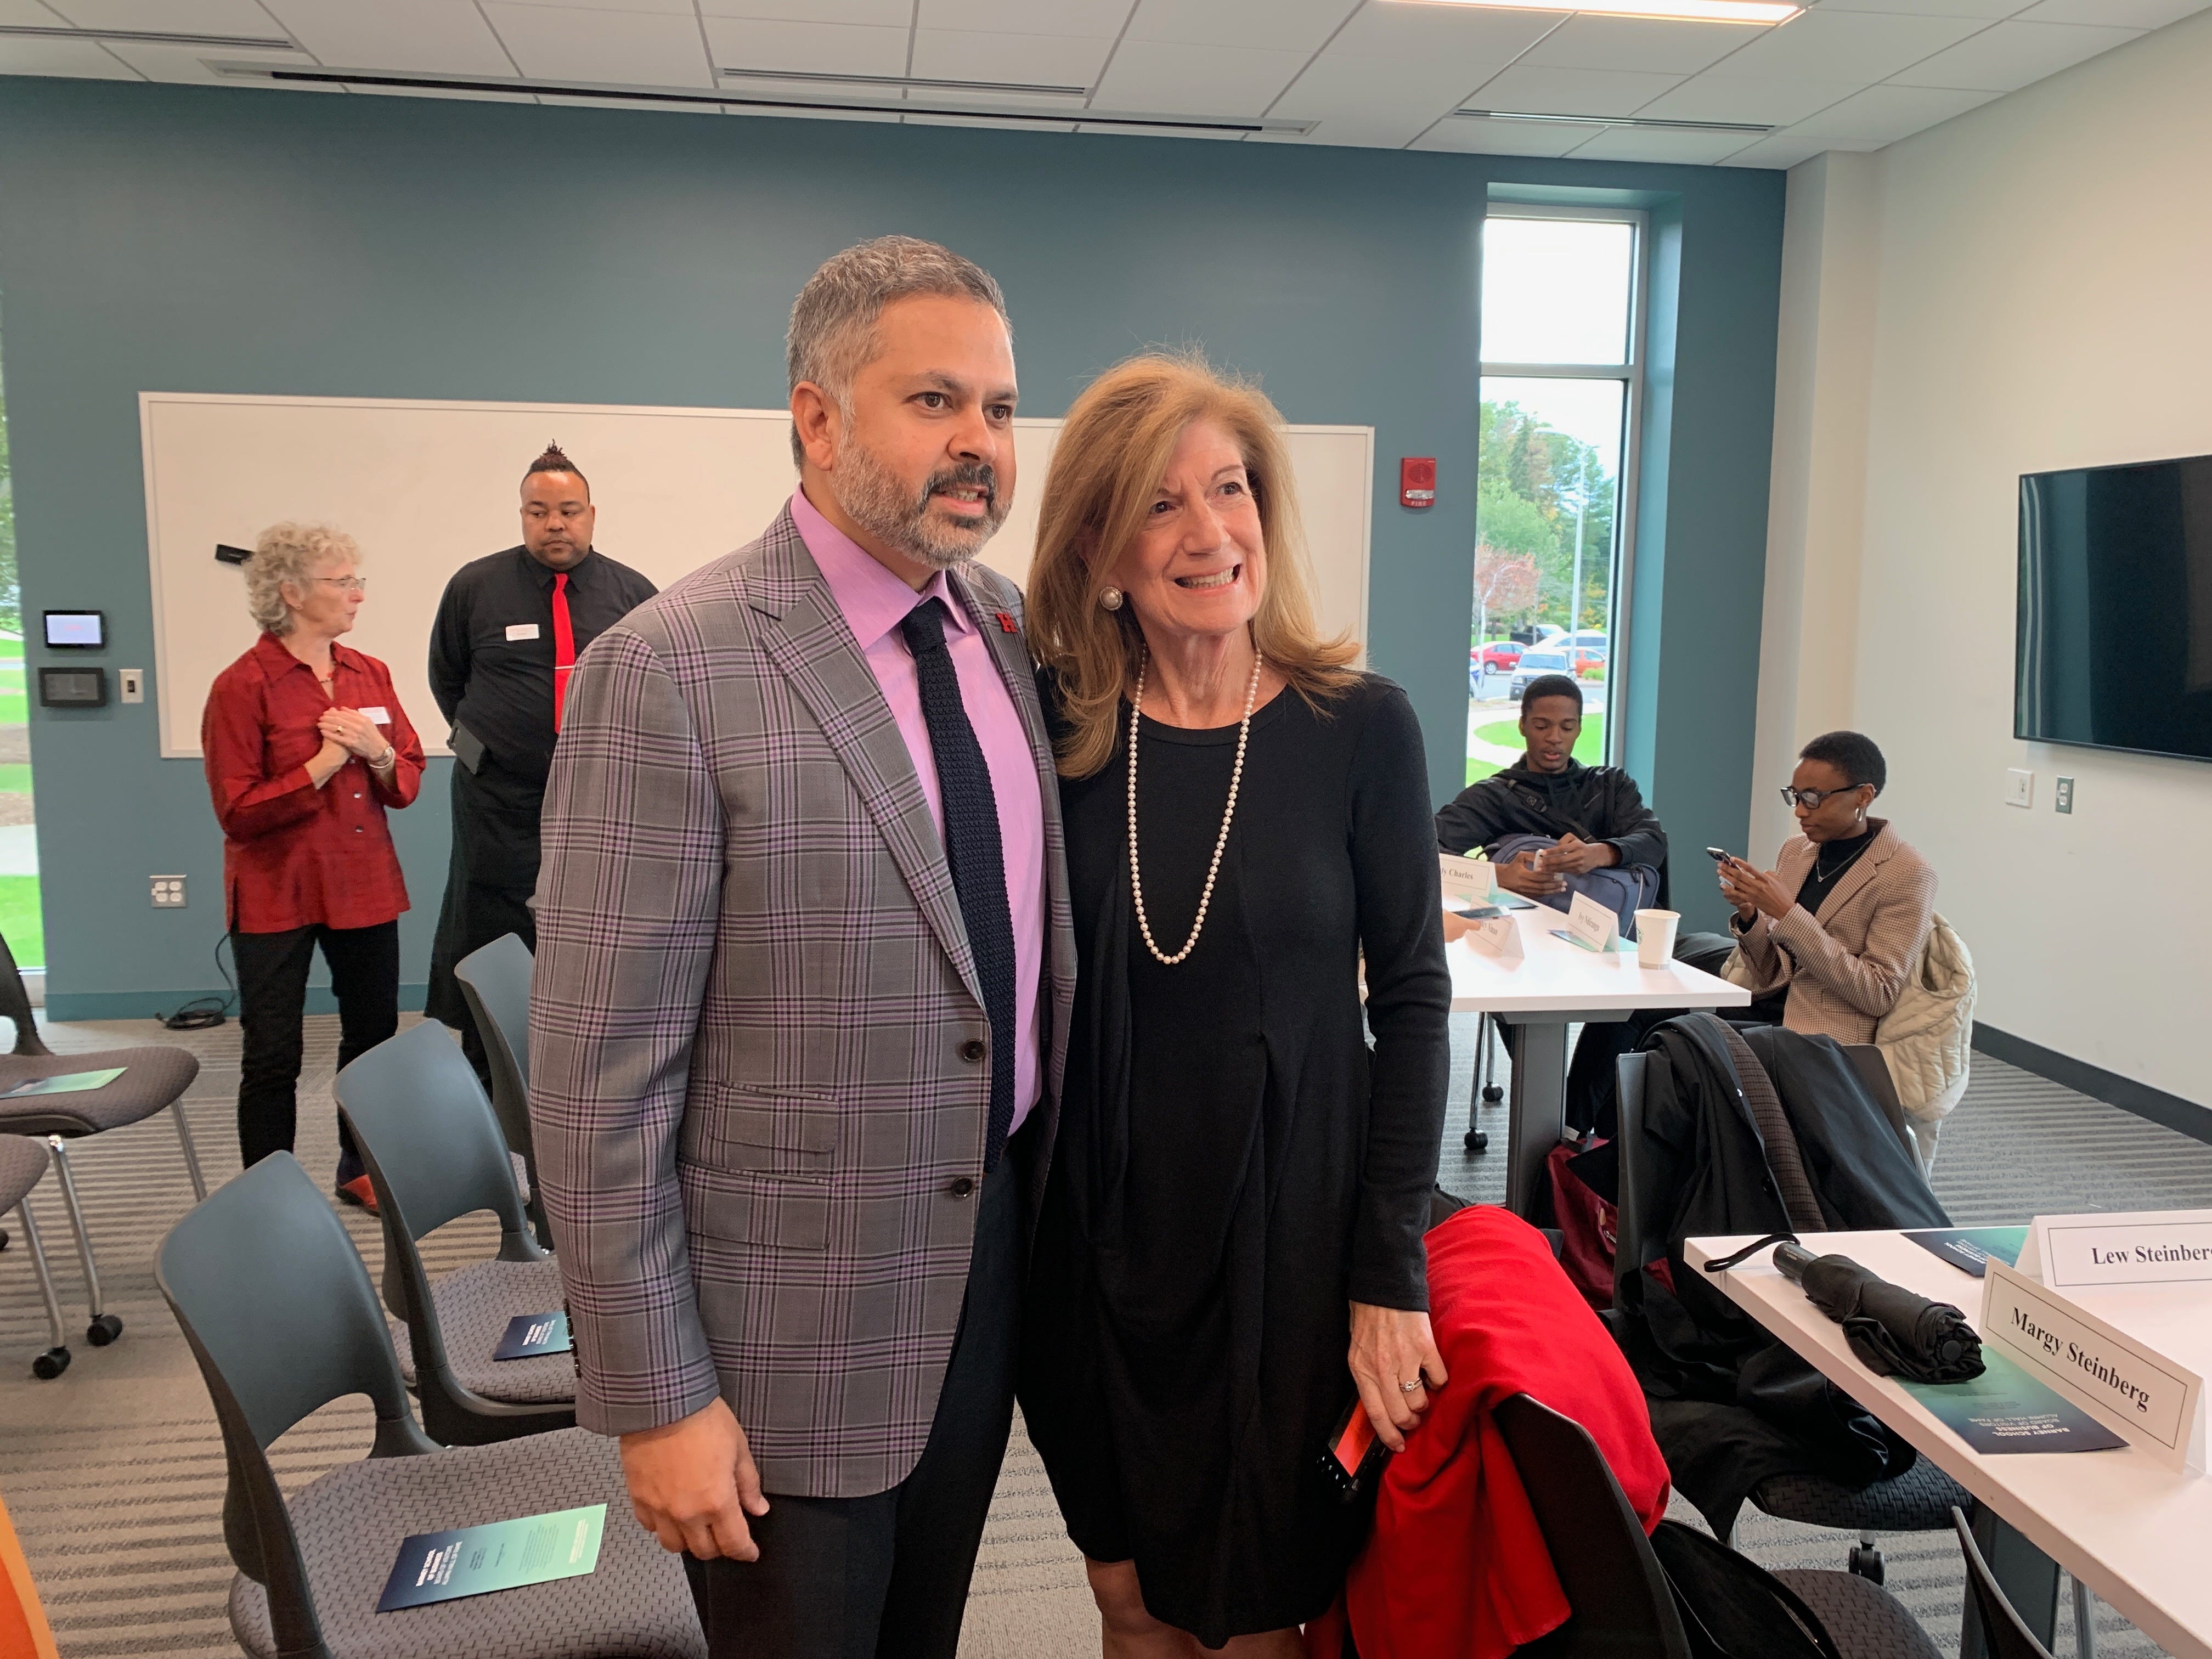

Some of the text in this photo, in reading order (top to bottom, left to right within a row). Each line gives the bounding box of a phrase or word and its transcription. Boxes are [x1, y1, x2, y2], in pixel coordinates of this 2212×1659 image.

[1449, 868, 1473, 879] Charles
[2091, 1244, 2212, 1265] Lew Steinber
[2011, 1307, 2150, 1413] Margy Steinberg
